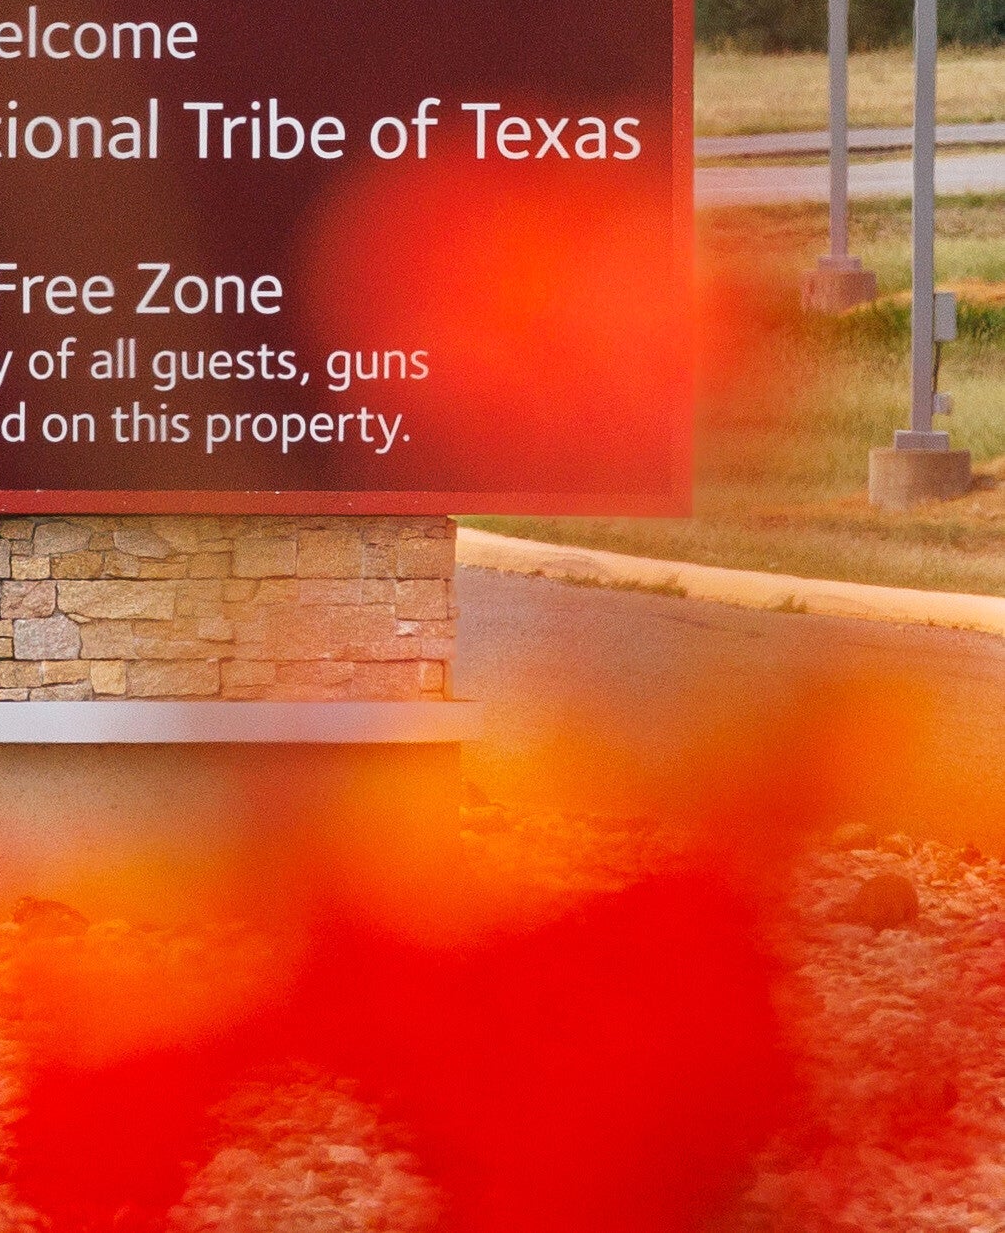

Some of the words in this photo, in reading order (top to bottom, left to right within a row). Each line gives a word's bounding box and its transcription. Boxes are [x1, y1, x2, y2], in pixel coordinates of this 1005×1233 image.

[182, 97, 346, 160] Tribe
[369, 97, 441, 160] of
[460, 102, 643, 160] Texas
[135, 262, 283, 315] Zone
[28, 336, 78, 380] of
[90, 337, 136, 380] all
[151, 343, 310, 392] guests,
[326, 350, 431, 392] guns
[42, 413, 96, 443] on
[110, 401, 191, 443] this
[206, 406, 411, 455] property.
